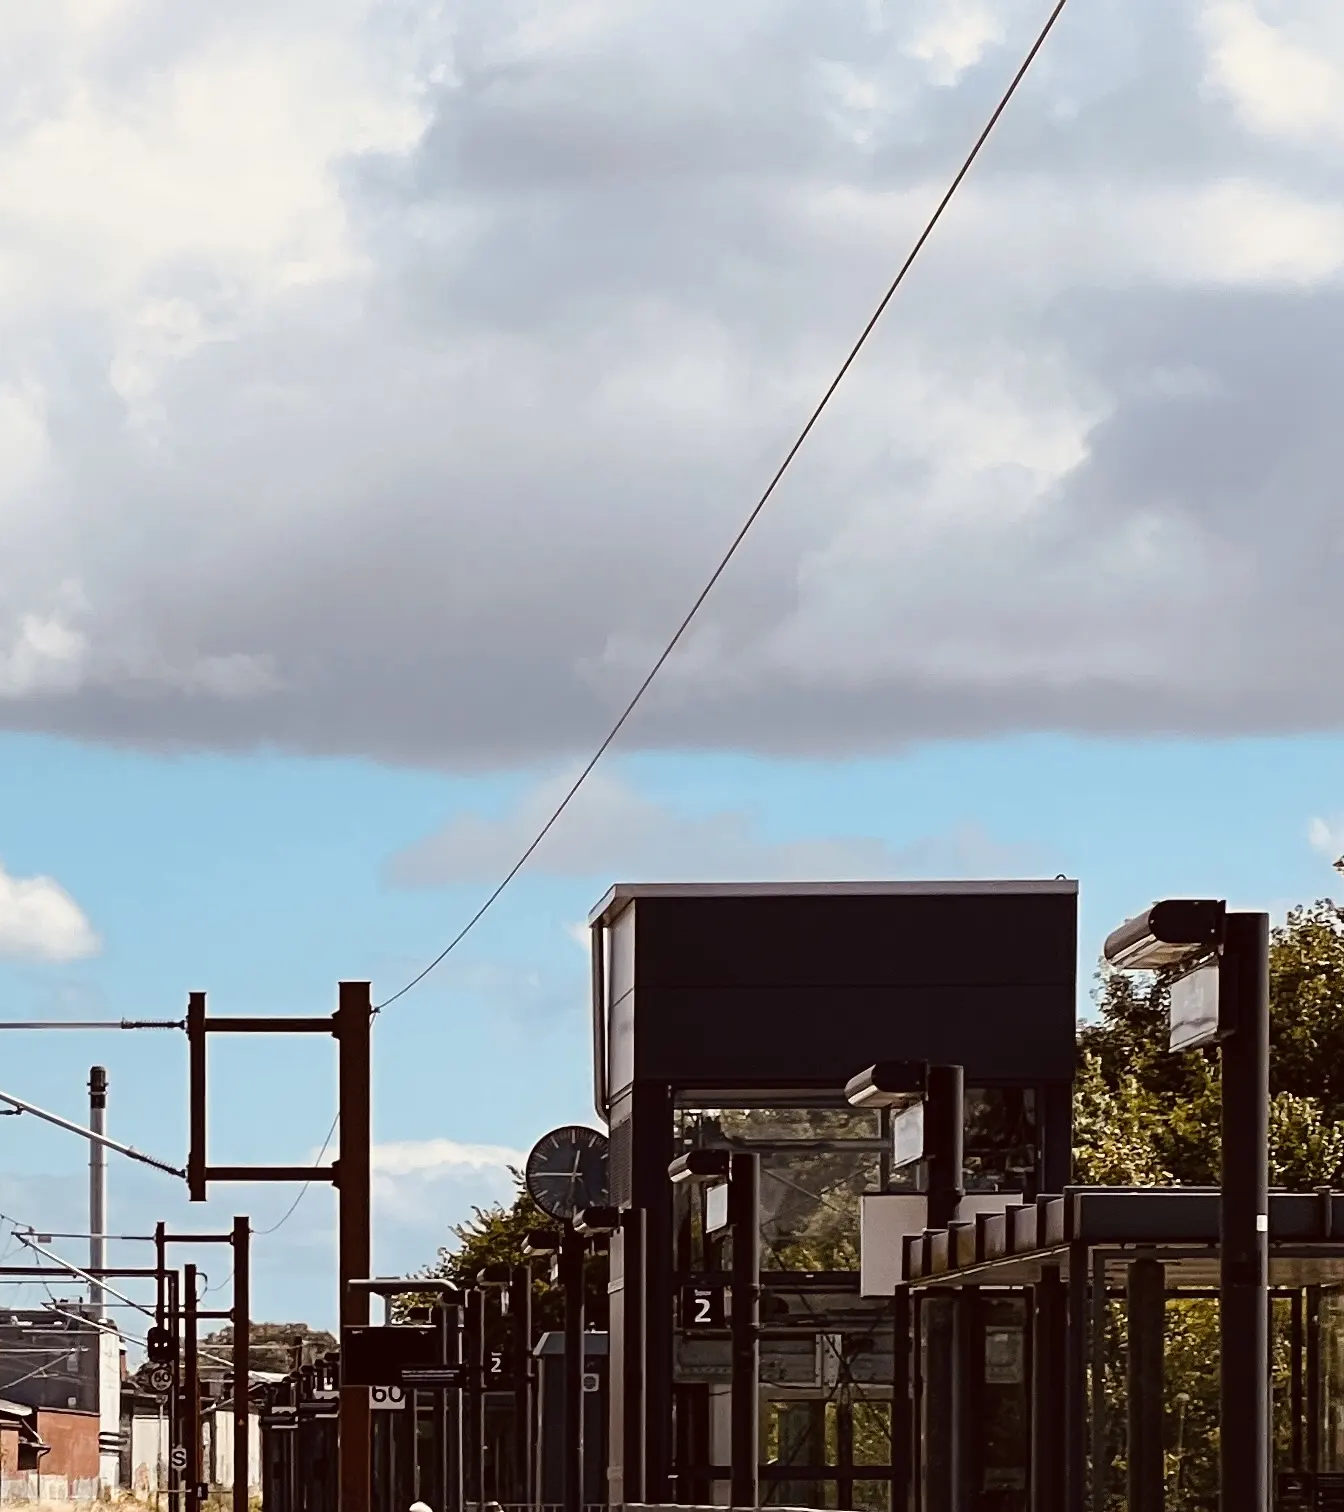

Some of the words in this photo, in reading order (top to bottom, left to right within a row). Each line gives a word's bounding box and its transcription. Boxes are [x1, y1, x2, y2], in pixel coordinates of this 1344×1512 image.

[695, 1299, 711, 1322] 2
[491, 1358, 502, 1372] 2
[154, 1372, 170, 1383] 60
[372, 1386, 405, 1402] 60
[172, 1451, 186, 1466] S
